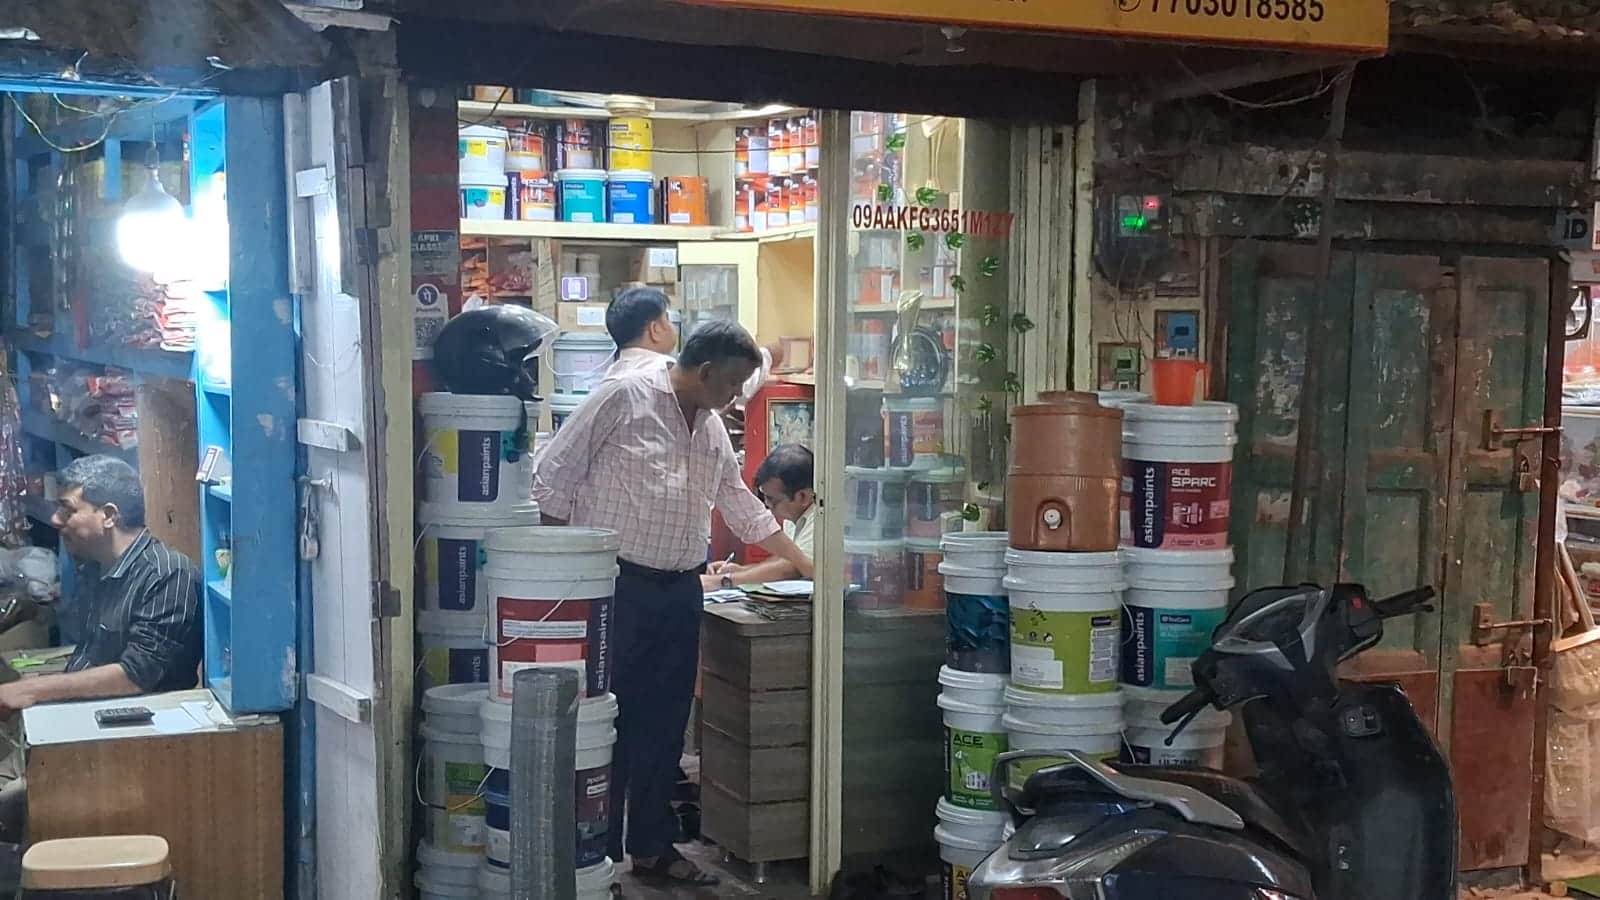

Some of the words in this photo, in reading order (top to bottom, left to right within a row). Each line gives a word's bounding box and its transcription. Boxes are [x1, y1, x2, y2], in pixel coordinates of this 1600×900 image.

[479, 436, 492, 497] asianpaints
[1171, 468, 1191, 476] ACE
[1171, 476, 1216, 488] SPARC
[1142, 466, 1158, 544] asianpaints
[457, 545, 468, 605] asianpaints
[595, 603, 608, 690] asianpaints
[1134, 611, 1147, 682] asianpaints
[953, 733, 984, 749] ACE
